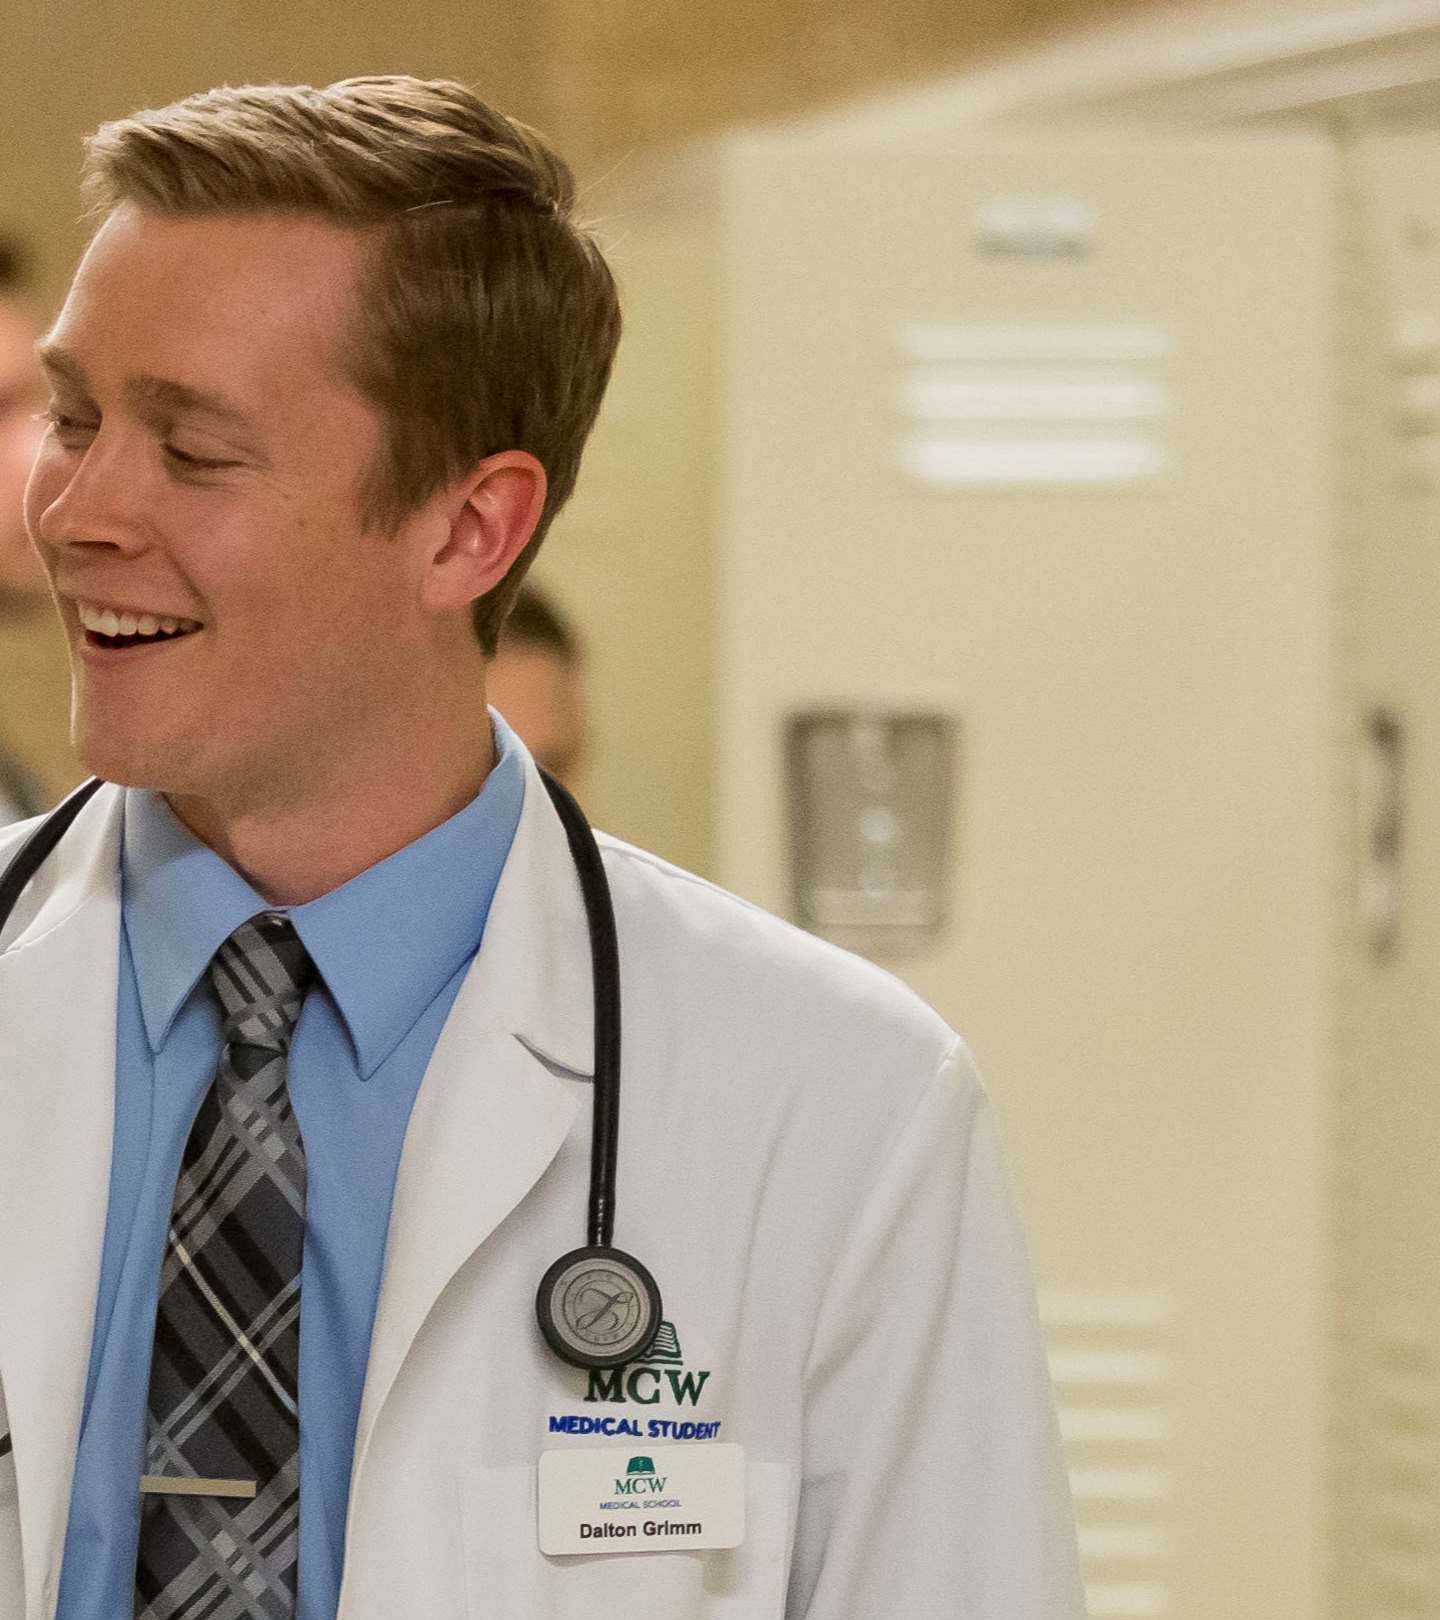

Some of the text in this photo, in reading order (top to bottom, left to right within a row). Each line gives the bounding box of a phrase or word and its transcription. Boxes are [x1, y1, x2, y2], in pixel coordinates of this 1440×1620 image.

[584, 1367, 711, 1406] MCW
[549, 1416, 721, 1440] MEDICAL STUDENT
[614, 1477, 668, 1495] MCW
[600, 1499, 682, 1510] MEDICAL SCHOOL
[580, 1520, 702, 1539] Dalton Grimm
